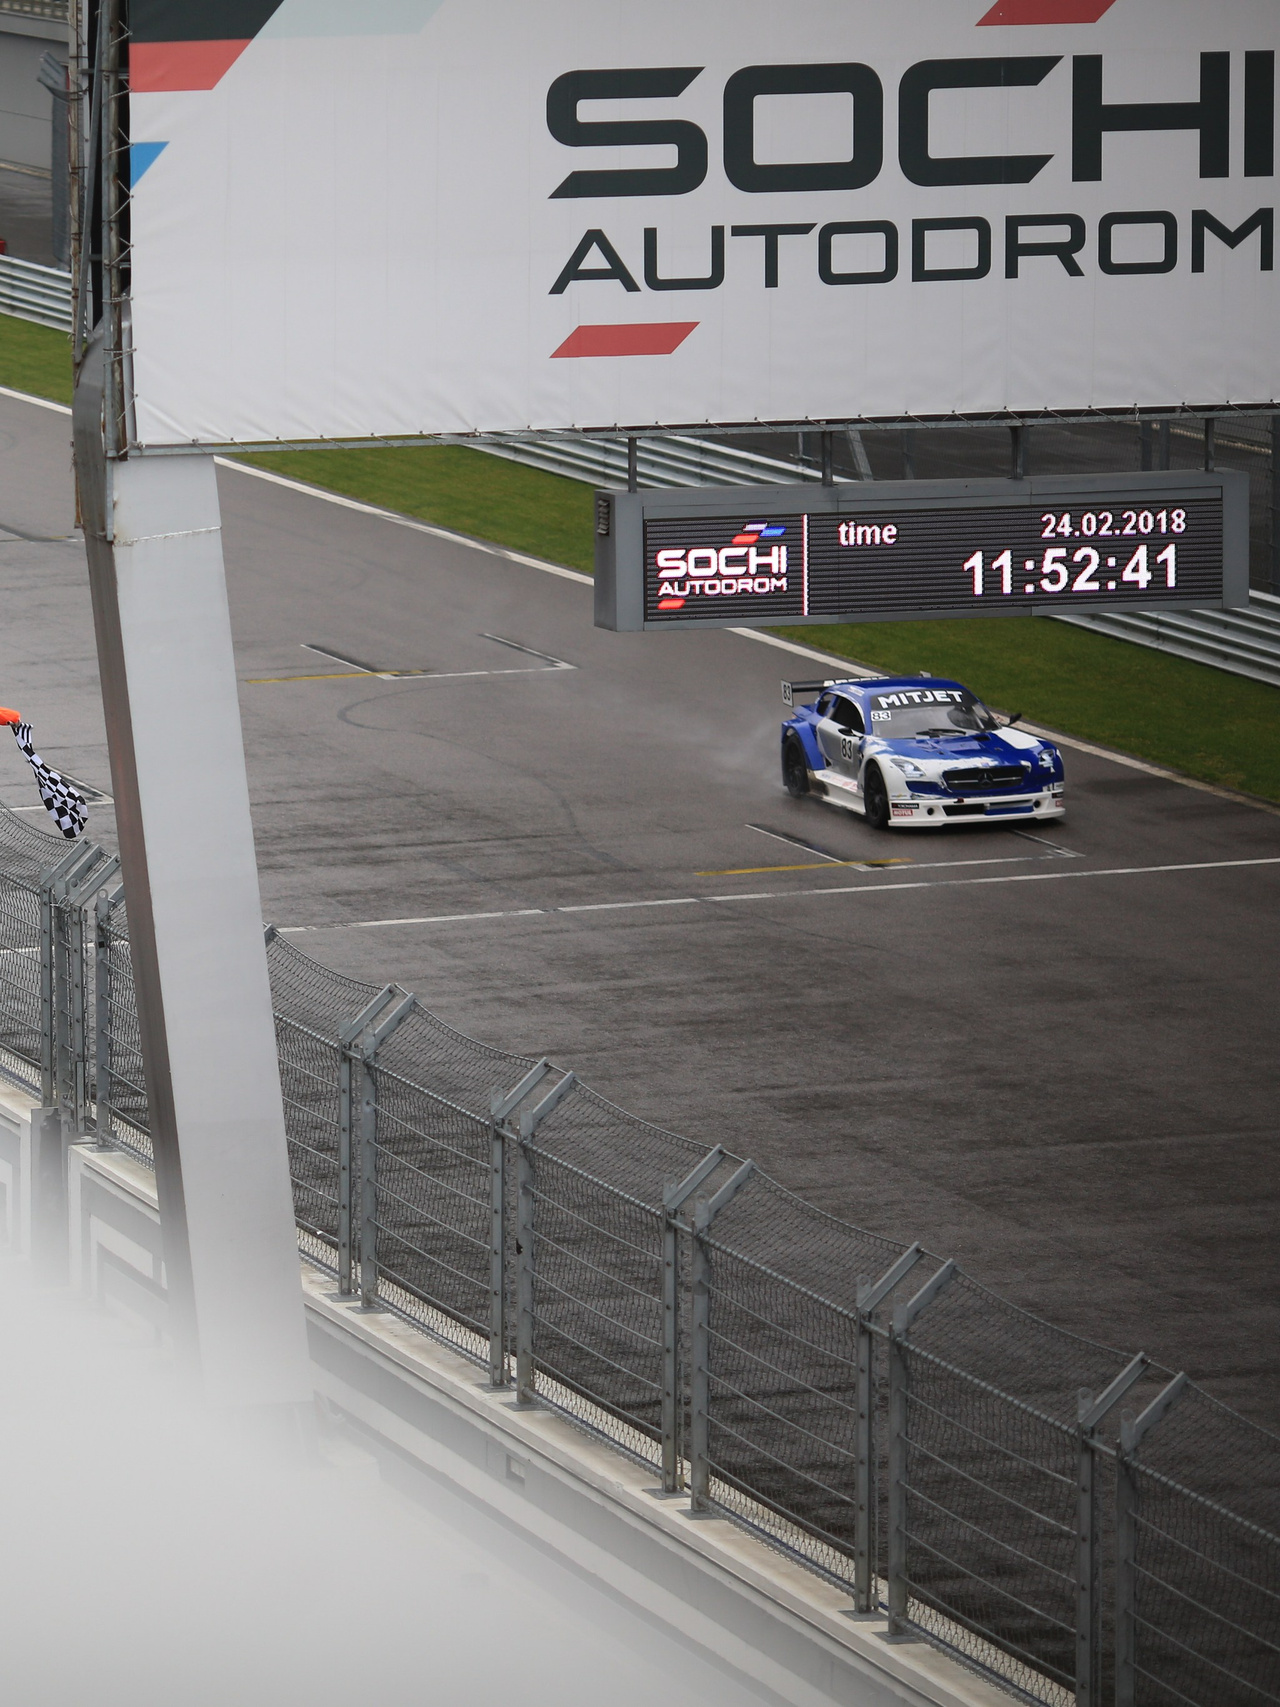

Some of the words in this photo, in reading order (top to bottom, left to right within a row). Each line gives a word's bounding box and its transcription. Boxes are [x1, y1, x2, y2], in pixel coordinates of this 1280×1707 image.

[546, 50, 1275, 199] SOCHI
[548, 207, 1274, 295] AUTODROM
[838, 520, 897, 546] time
[1041, 509, 1186, 539] 24.02.2018
[656, 545, 788, 578] SOCHI
[963, 544, 1179, 595] 11:52:41
[657, 577, 788, 597] AUTODROM
[877, 690, 963, 709] MITJET
[872, 711, 890, 720] 83
[841, 738, 853, 760] 83
